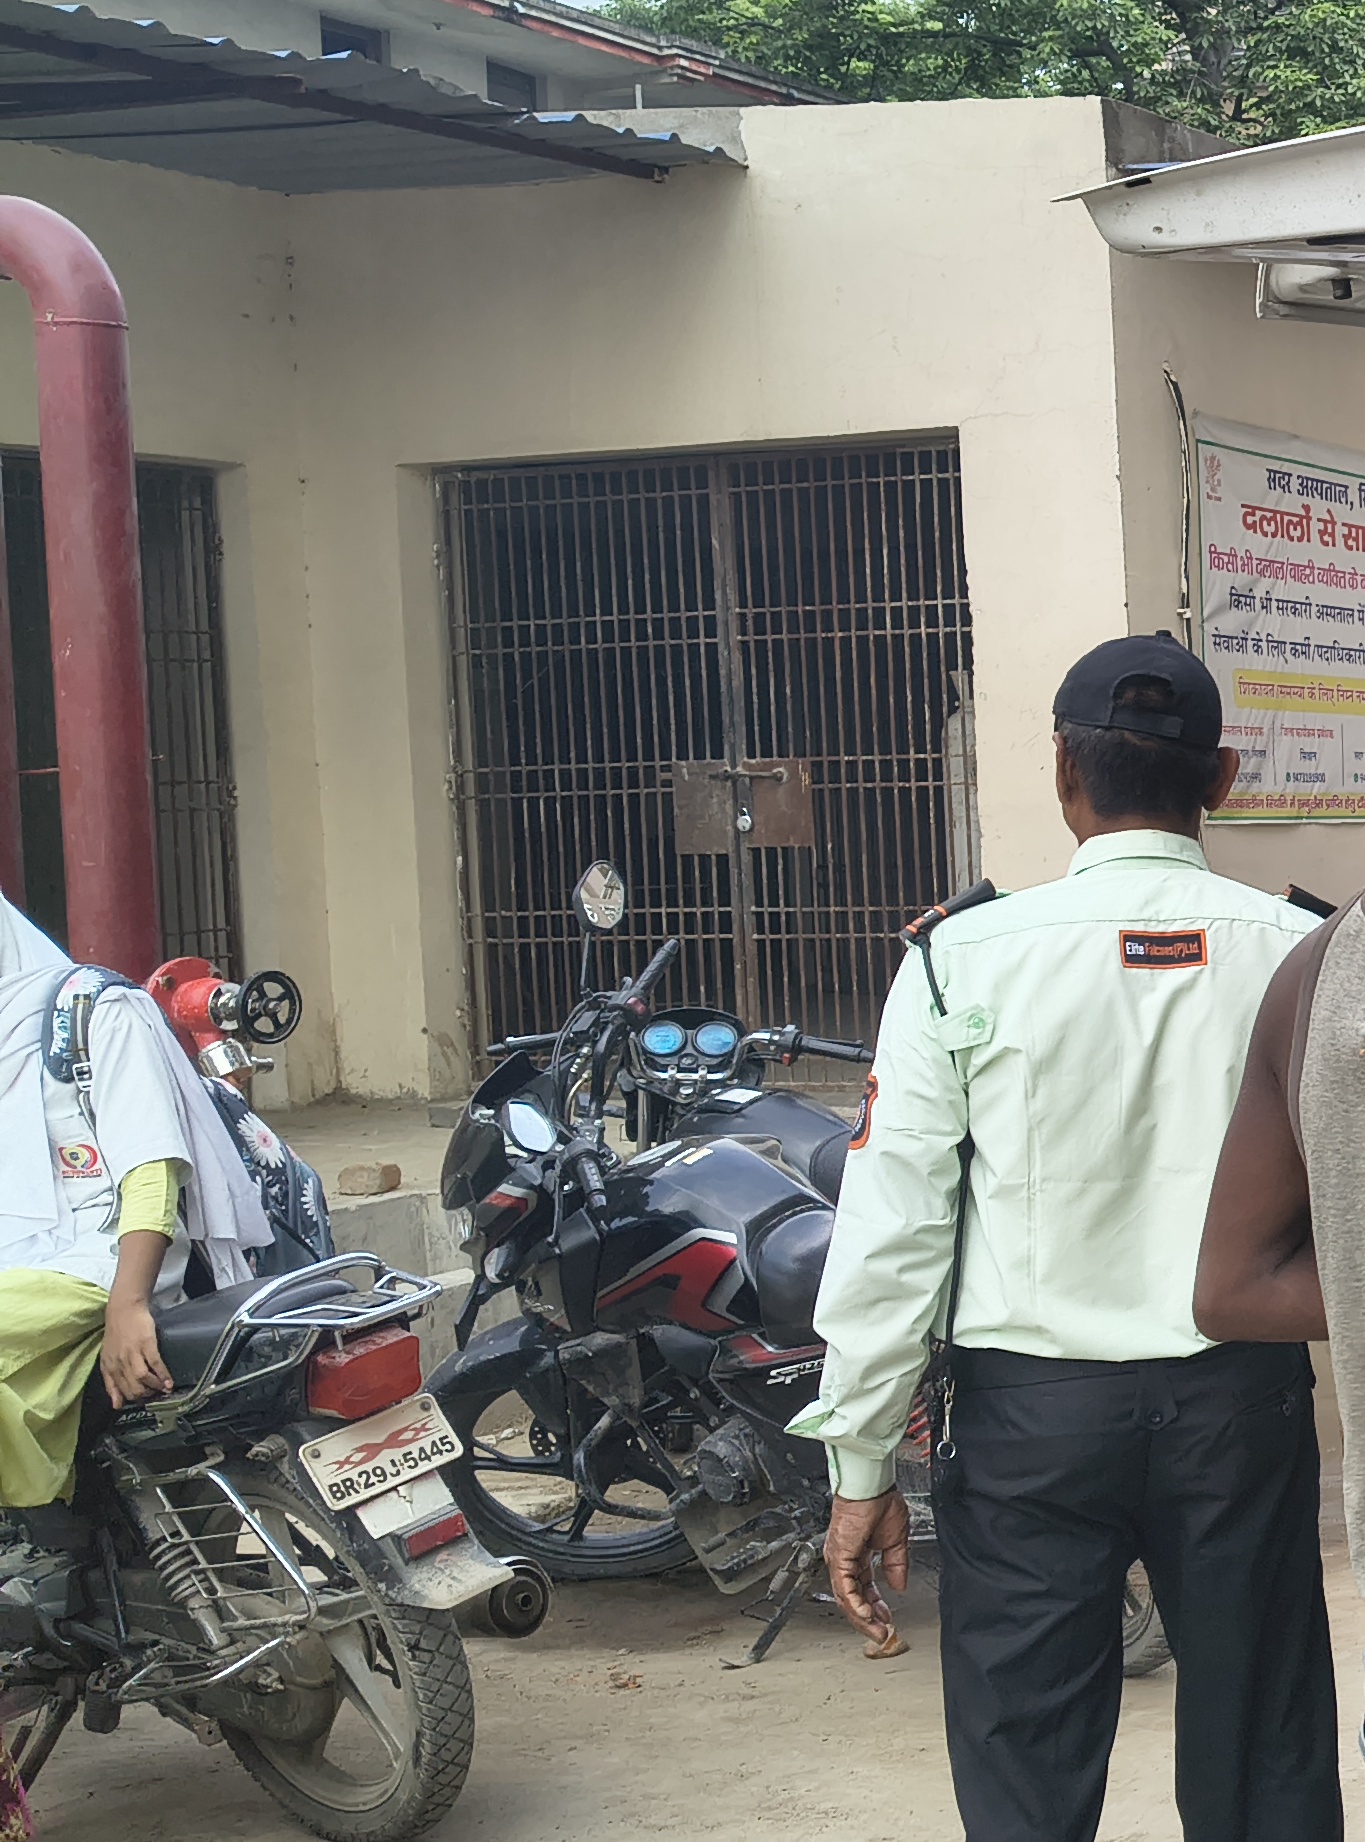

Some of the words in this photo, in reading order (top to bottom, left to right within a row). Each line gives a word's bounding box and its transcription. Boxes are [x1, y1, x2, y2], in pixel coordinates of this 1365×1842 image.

[1266, 468, 1293, 495] सदर
[1297, 475, 1354, 511] अस्पताल,
[1241, 503, 1313, 543] दलालों
[1317, 508, 1338, 547] से
[1209, 543, 1239, 575] किसी
[1239, 549, 1254, 577] भी
[1348, 567, 1359, 591] के
[1229, 586, 1257, 614] किसी
[1259, 591, 1273, 616] भी
[1275, 596, 1313, 620] सरकारी
[1316, 604, 1356, 626] अस्पताल
[1251, 631, 1264, 657] के
[1265, 633, 1288, 665] लिए
